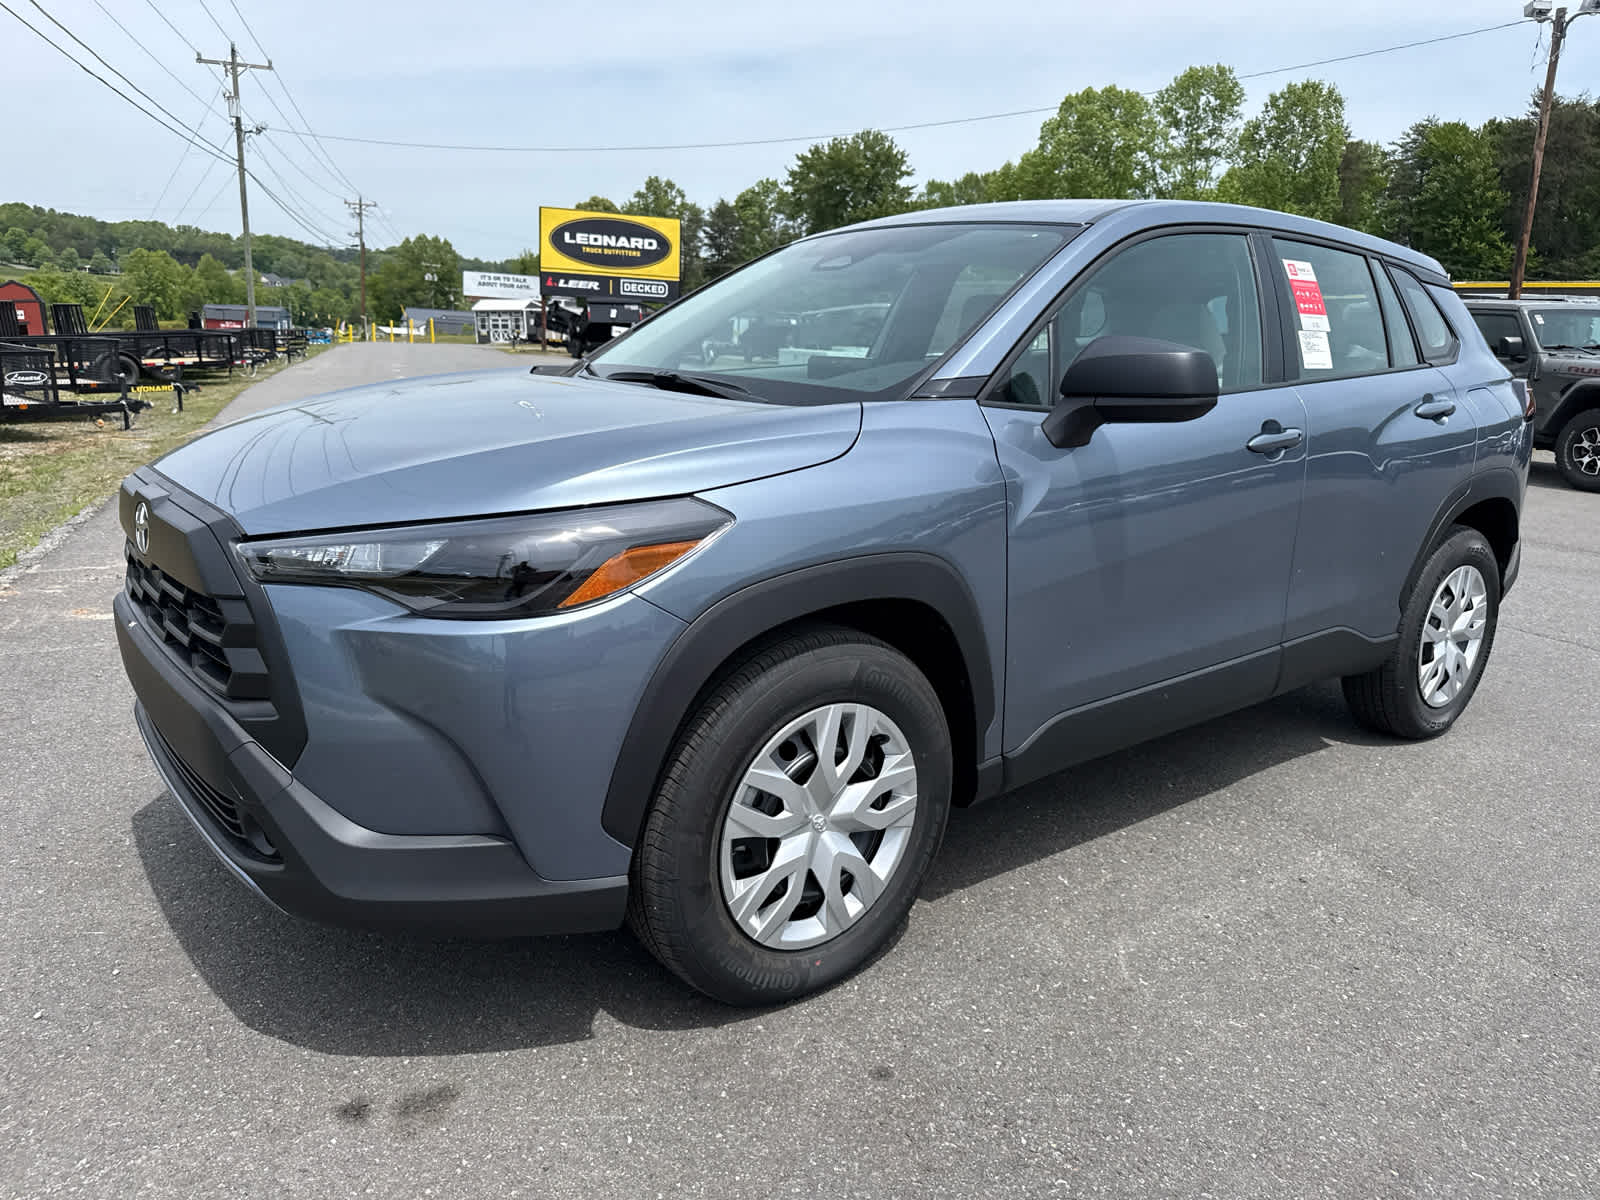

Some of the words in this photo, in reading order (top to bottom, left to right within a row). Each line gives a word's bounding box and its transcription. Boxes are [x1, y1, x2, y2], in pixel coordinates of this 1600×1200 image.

[564, 231, 658, 251] LEONARD
[582, 246, 602, 254] TRUCK
[603, 248, 641, 257] OUTFITTERS
[558, 278, 600, 290] LEER
[623, 282, 665, 294] DECKED
[130, 385, 174, 393] LEONARD
